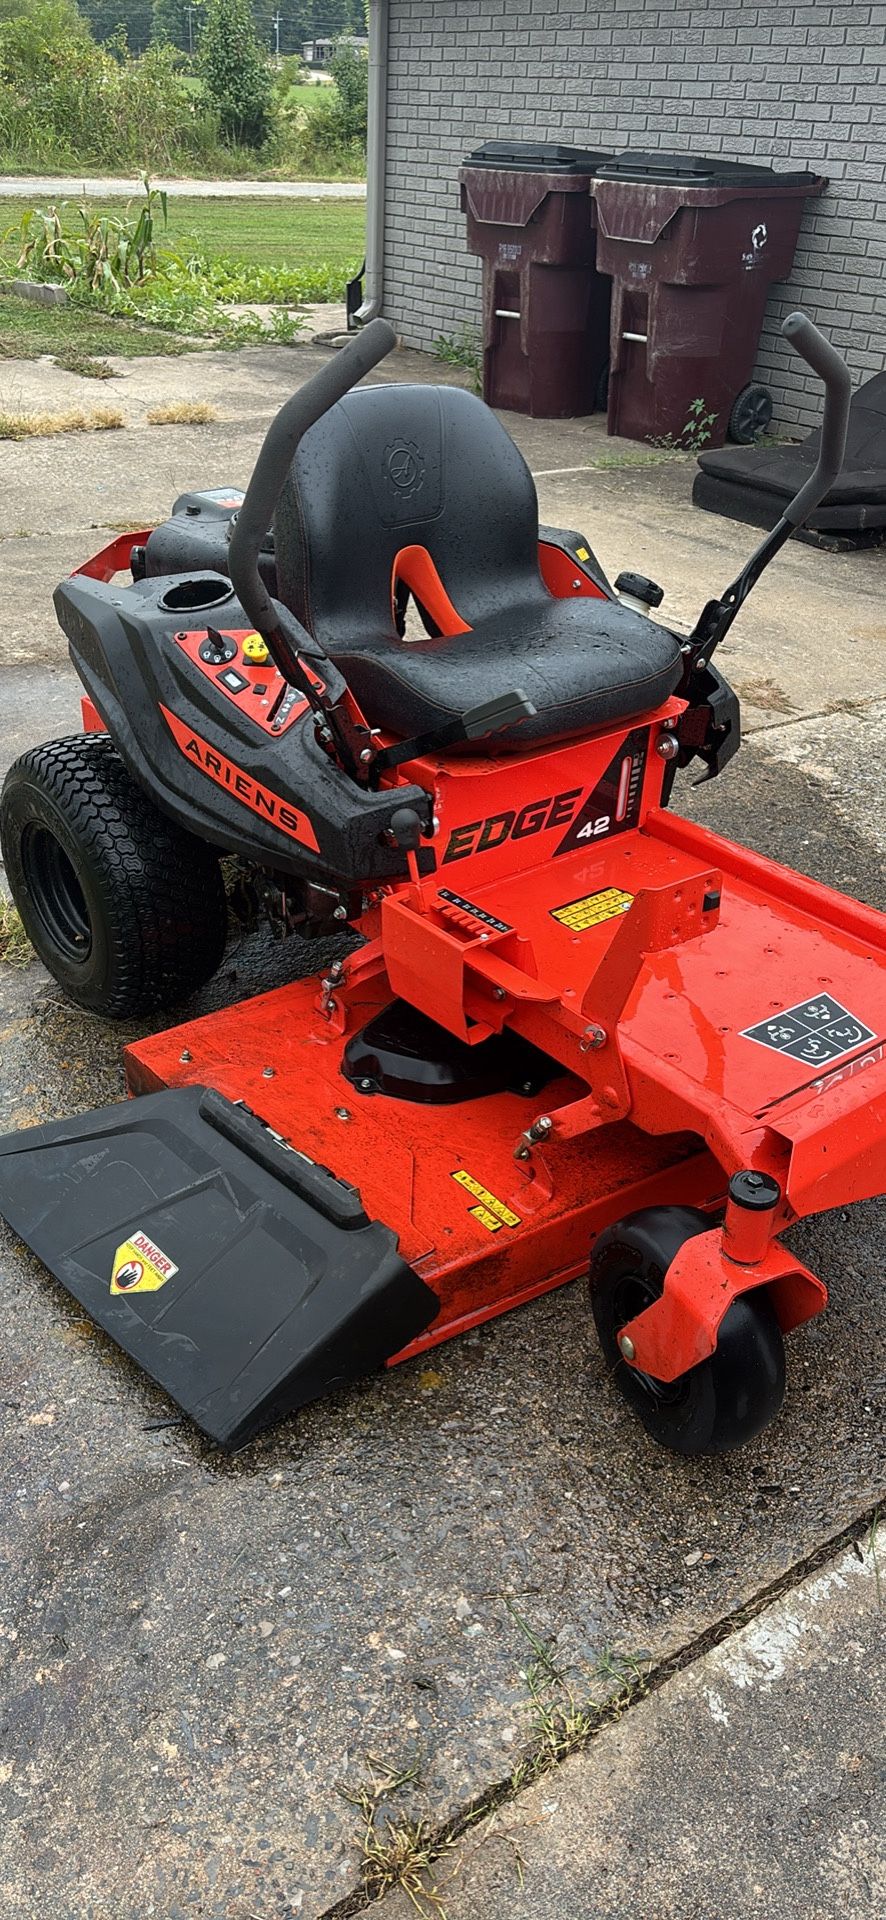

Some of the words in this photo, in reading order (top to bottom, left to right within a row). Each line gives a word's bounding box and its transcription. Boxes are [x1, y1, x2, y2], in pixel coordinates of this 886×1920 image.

[185, 739, 298, 832] ARIENS
[442, 787, 584, 865] EDGE
[576, 815, 611, 839] 42
[134, 1236, 172, 1274] DANGER
